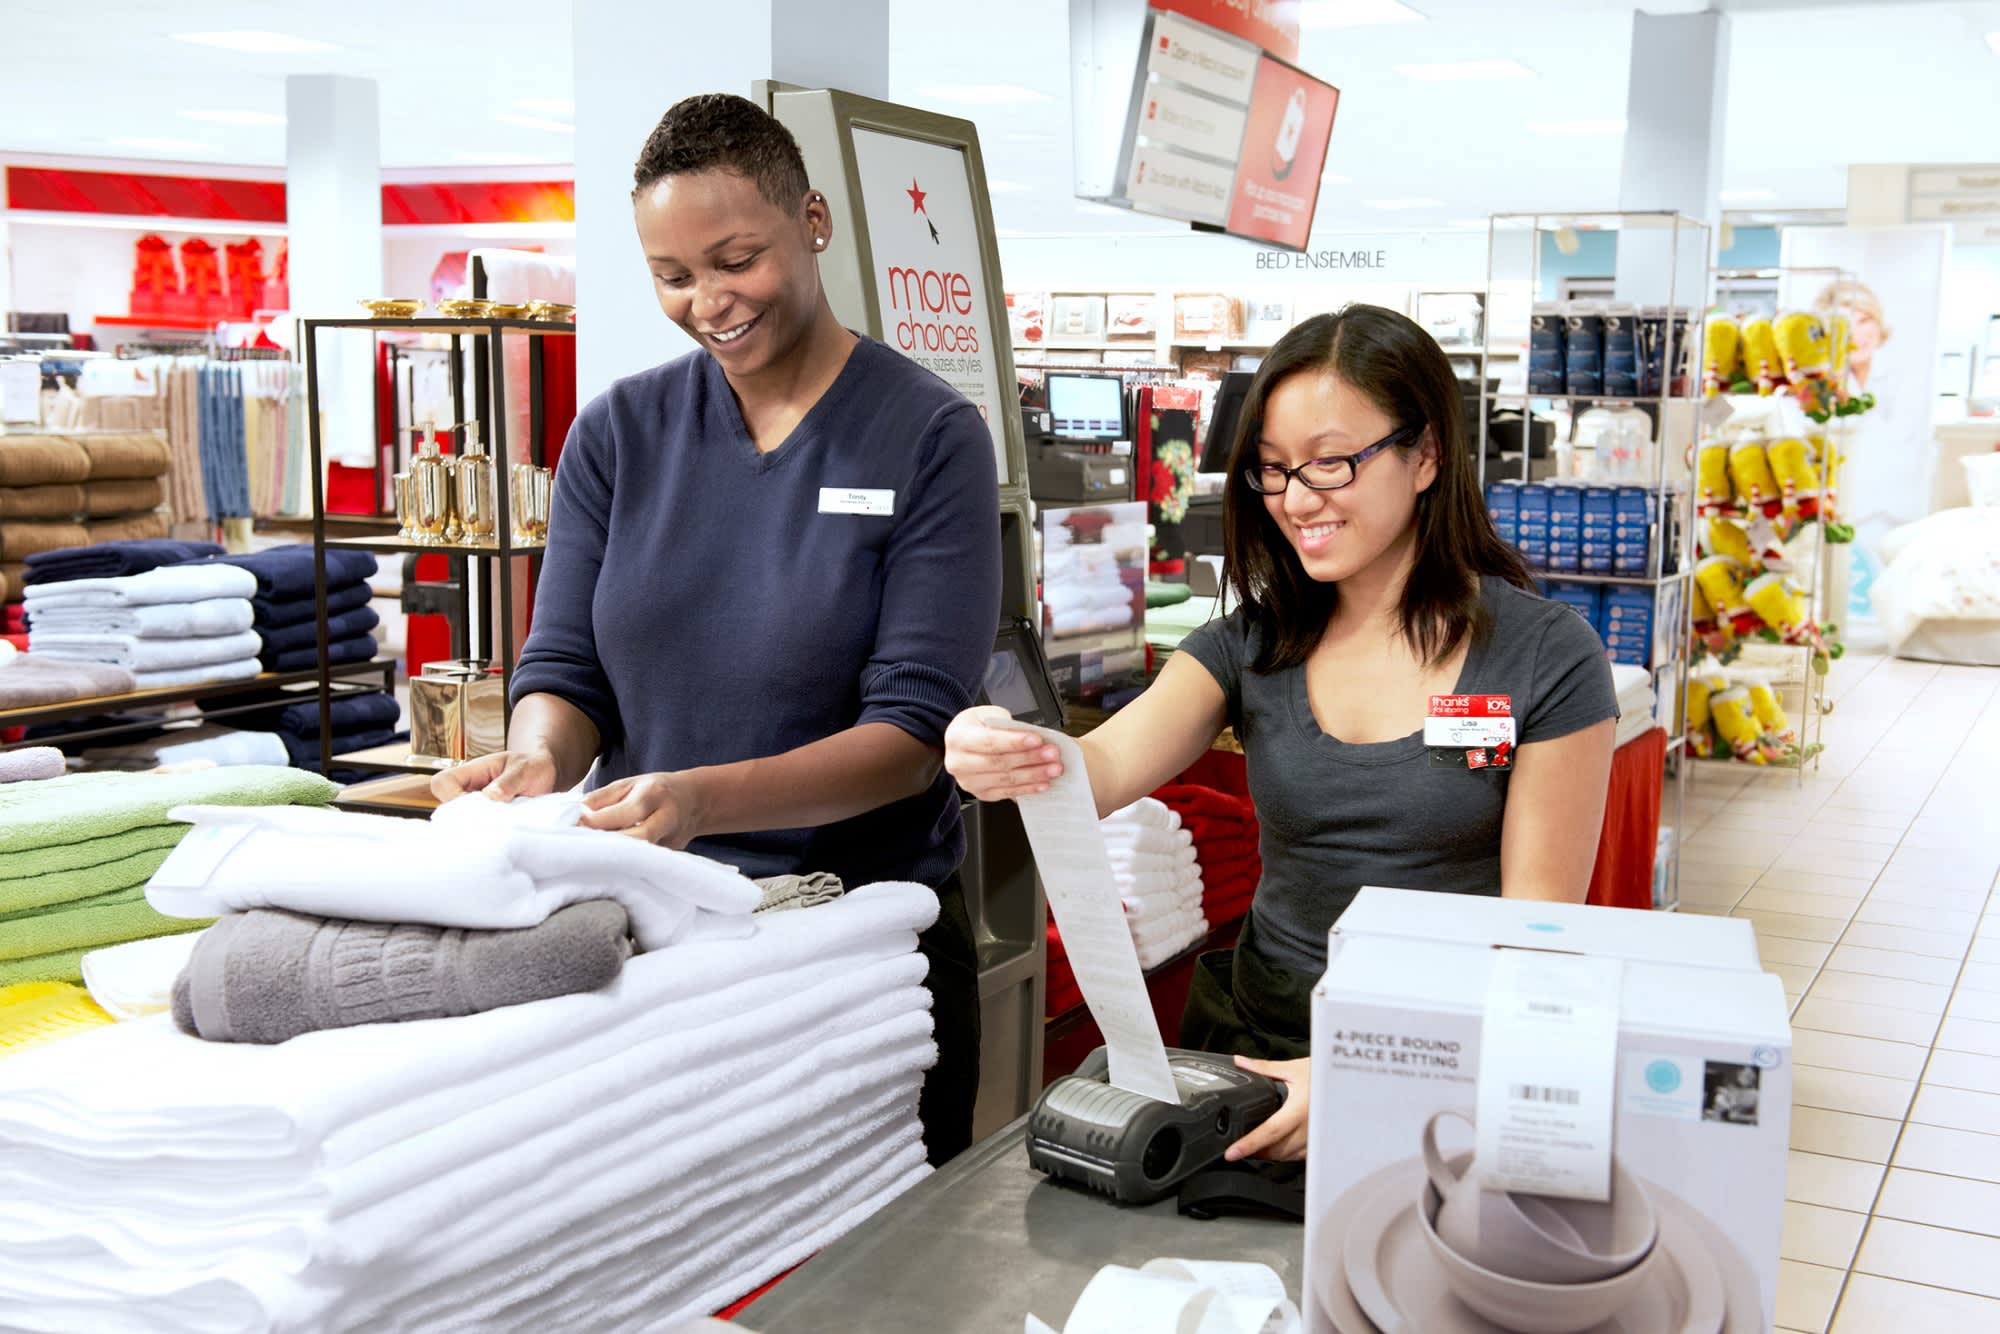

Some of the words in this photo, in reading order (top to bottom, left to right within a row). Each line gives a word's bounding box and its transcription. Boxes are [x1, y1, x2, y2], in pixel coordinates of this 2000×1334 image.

[1256, 252, 1290, 269] BED
[1295, 250, 1385, 270] ENSEMBLE
[888, 266, 972, 315] more
[897, 312, 979, 353] choices
[958, 354, 983, 376] styles
[1432, 696, 1470, 707] thanks
[1486, 699, 1511, 711] 10%
[1333, 1030, 1395, 1046] 4-PIECE
[1401, 1036, 1461, 1053] ROUND
[1332, 1045, 1384, 1061] PLACE
[1391, 1051, 1459, 1068] SETTING
